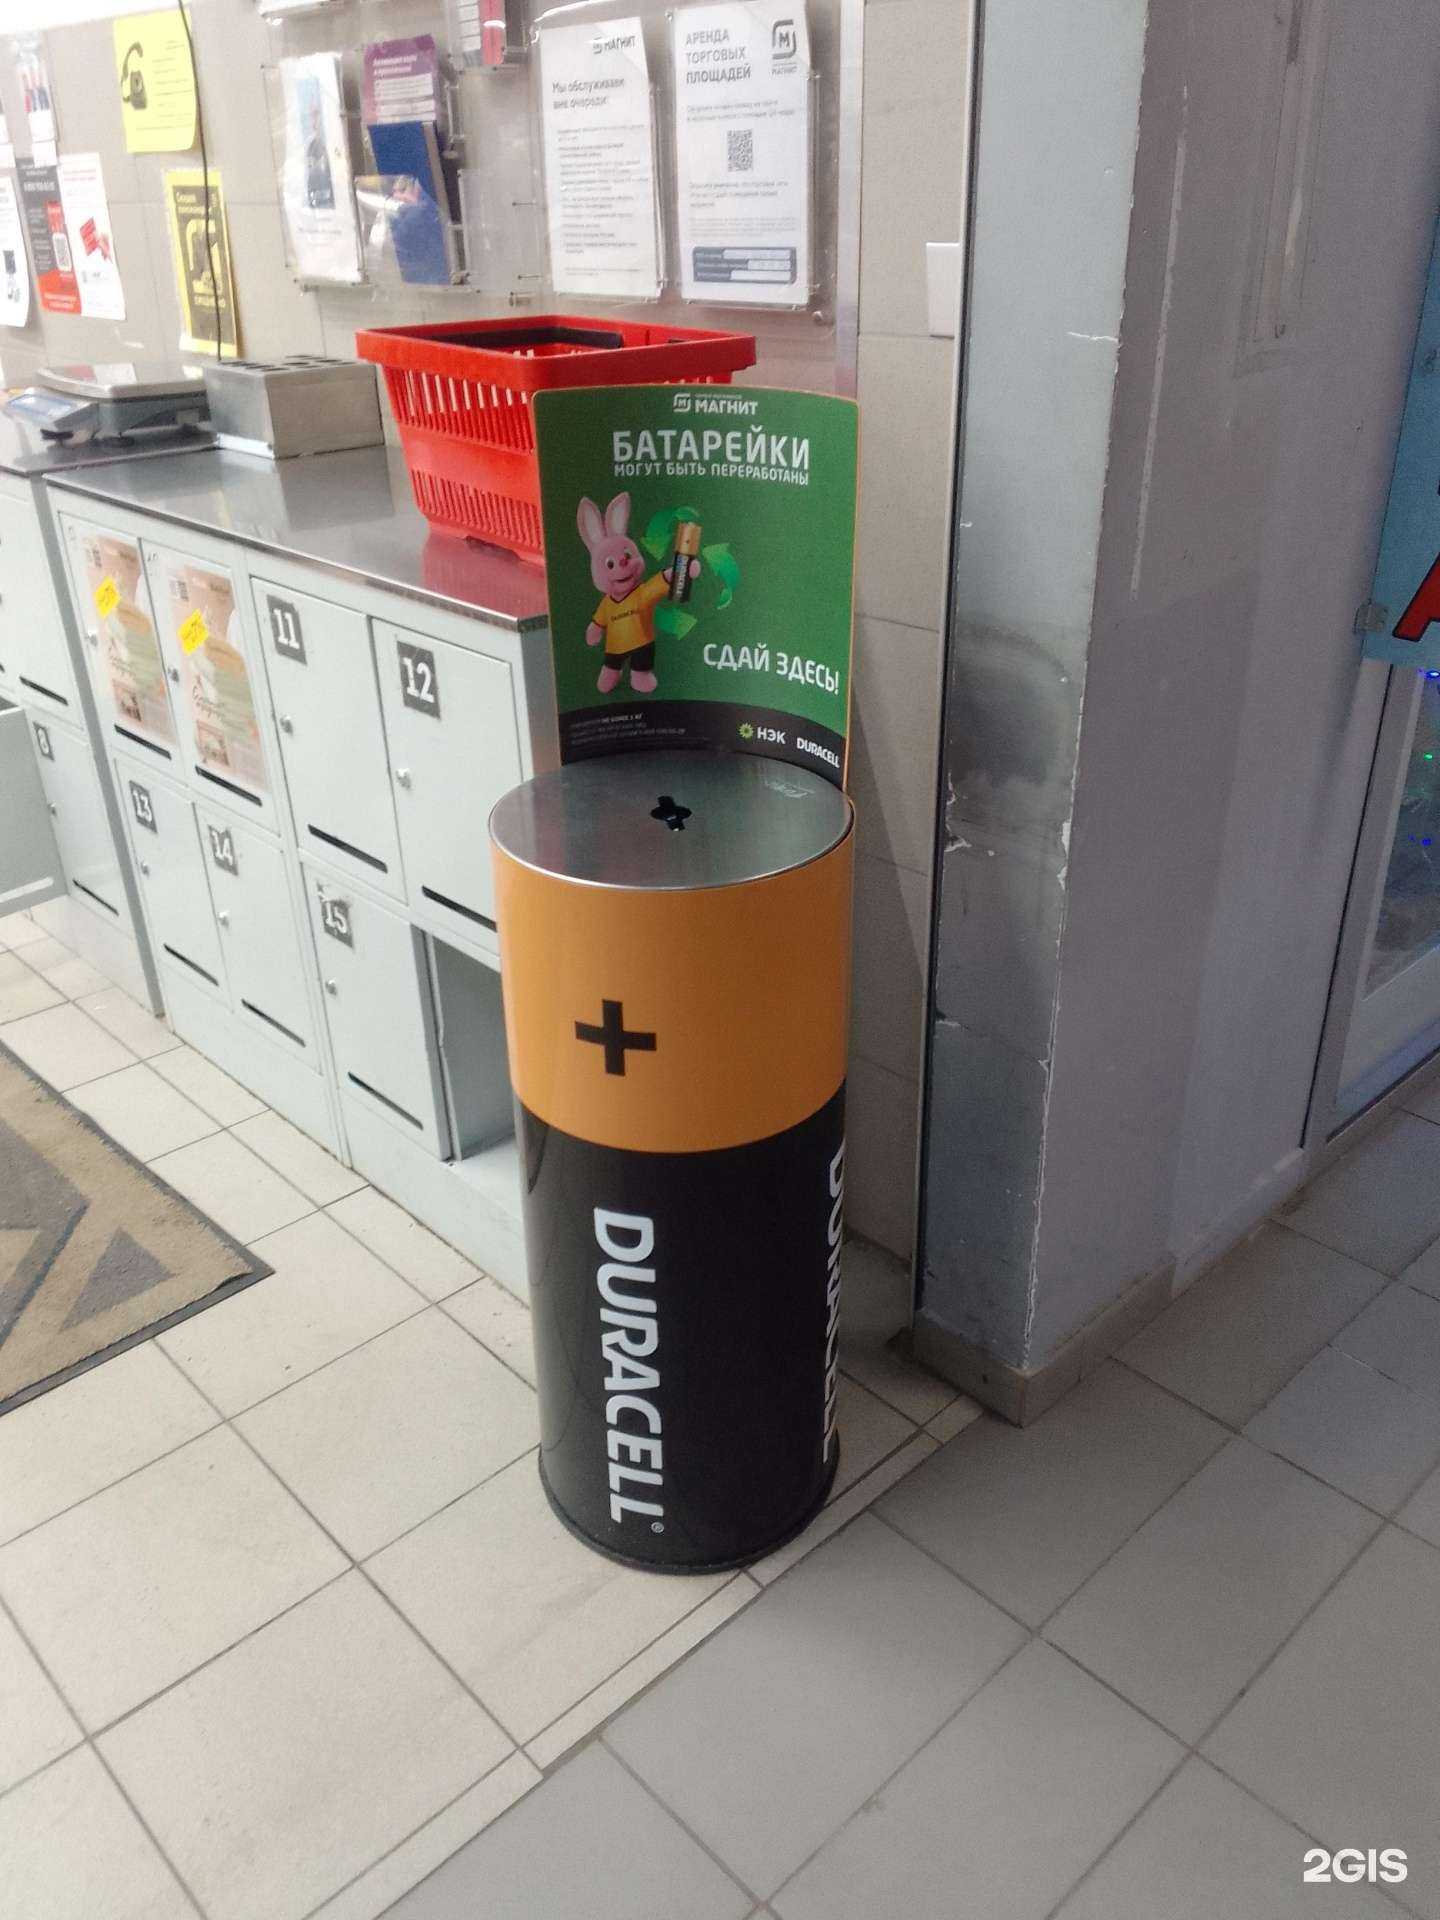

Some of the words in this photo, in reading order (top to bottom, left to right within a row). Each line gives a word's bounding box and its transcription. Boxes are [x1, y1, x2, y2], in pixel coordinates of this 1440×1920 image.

[604, 35, 636, 51] МАГНИТ
[685, 29, 730, 46] АРЕНДА
[685, 46, 747, 65] ТОРГОВЫХ
[685, 63, 752, 85] ПЛОЩАДЕЙ
[694, 400, 758, 416] МАГНИТ
[612, 424, 811, 471] БАТАРЕЙКИ
[613, 461, 661, 477] МОГУТ
[665, 461, 706, 476] БЫТЬ
[710, 463, 810, 486] ПЕРЕРАБОТАНЫ
[273, 607, 301, 650] 11
[402, 656, 435, 703] 12
[703, 642, 771, 672] СДАЙ
[776, 651, 839, 696] ЗДЕСЬ!
[757, 726, 786, 745] НЭК
[796, 737, 840, 769] DURACELL
[132, 789, 153, 823] 13
[211, 831, 234, 867] 14
[325, 901, 347, 934] 15
[593, 1207, 664, 1524] DURACELL
